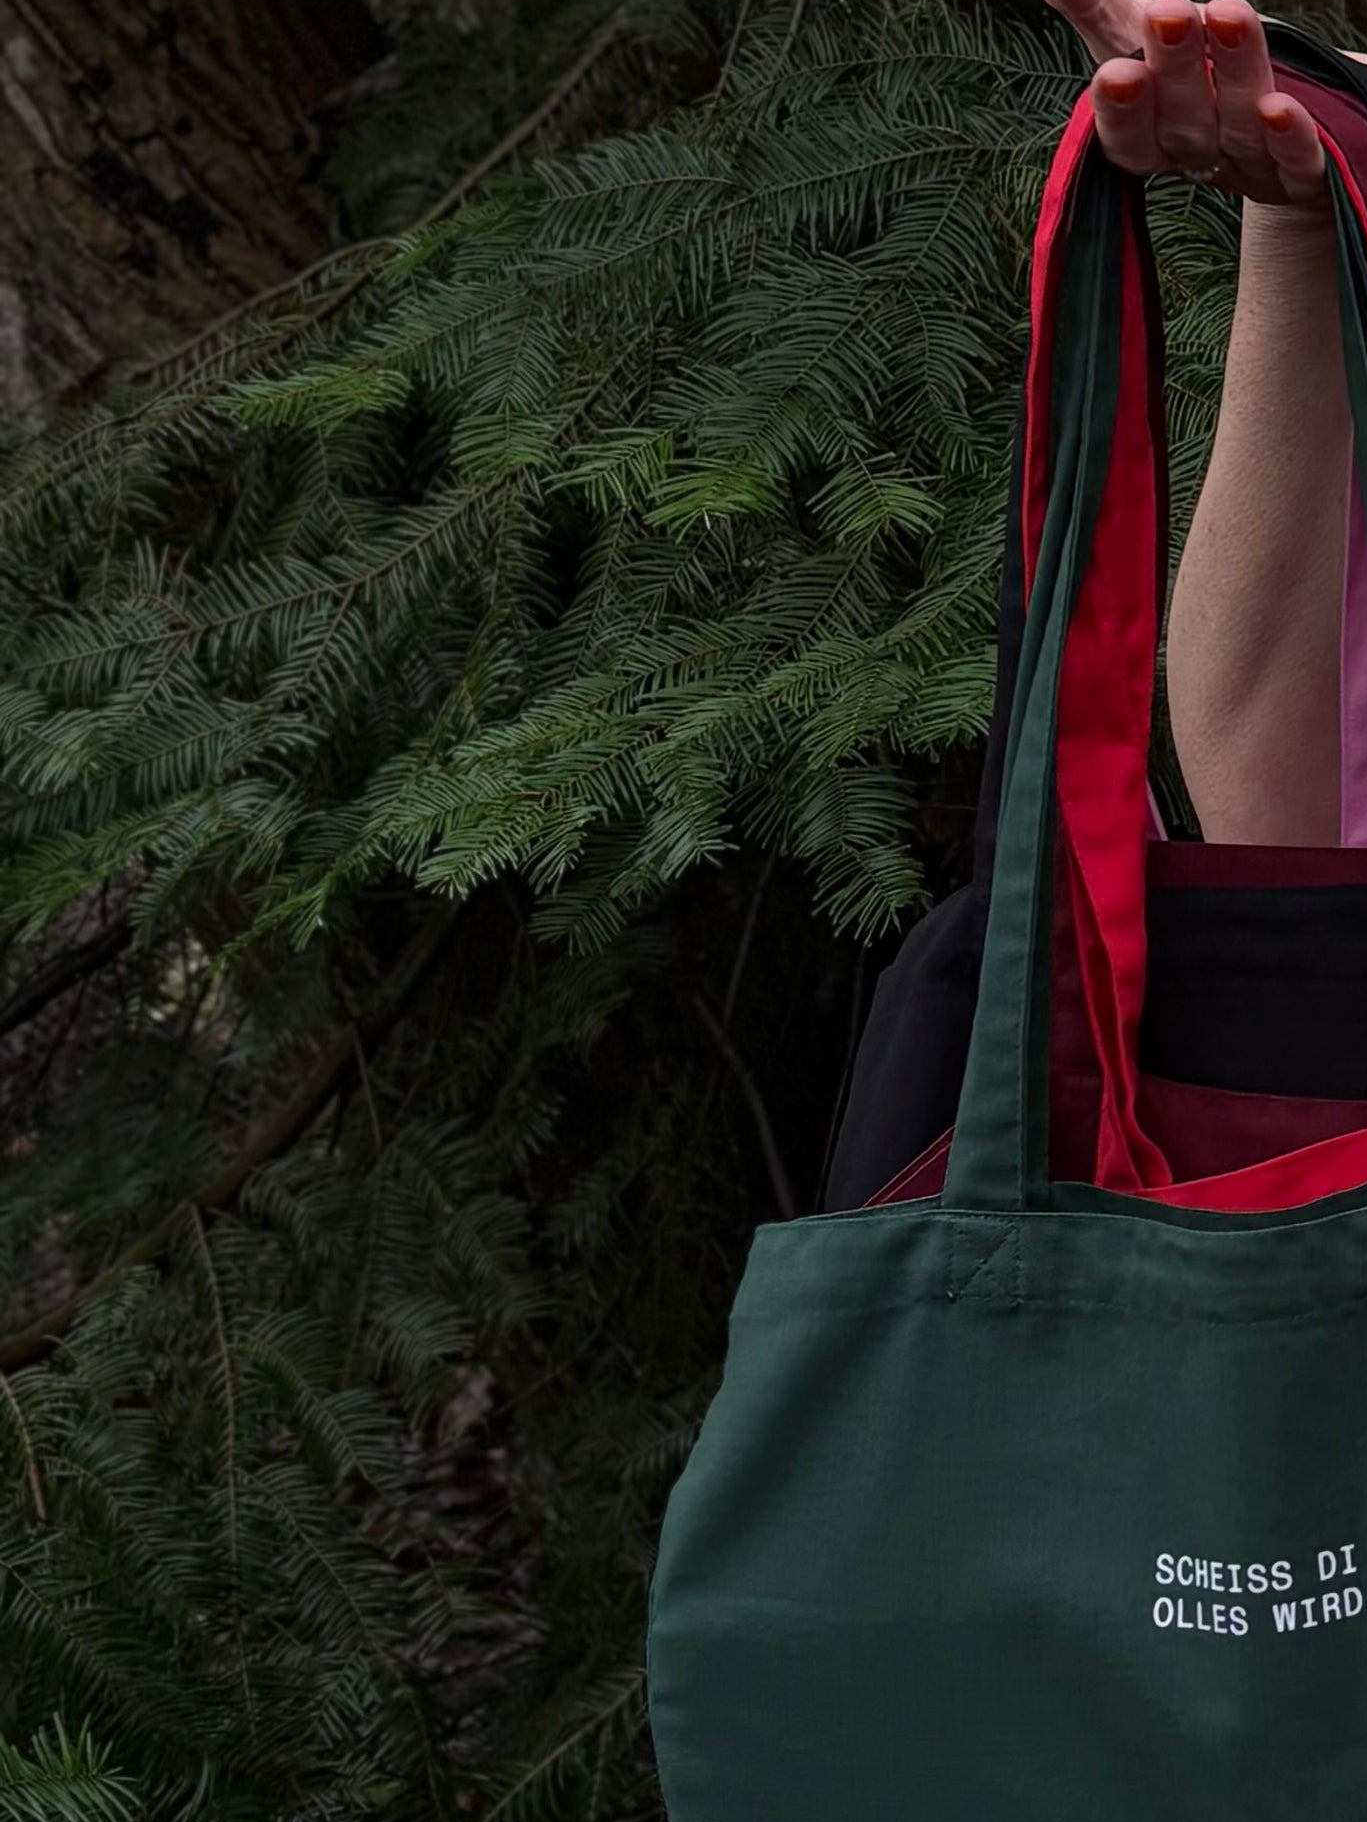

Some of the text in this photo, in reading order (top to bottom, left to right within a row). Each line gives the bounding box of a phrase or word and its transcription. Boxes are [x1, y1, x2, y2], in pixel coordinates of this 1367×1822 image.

[1155, 1553, 1293, 1594] SCHEISS
[1318, 1543, 1357, 1581] DI
[1153, 1596, 1249, 1636] OLLES
[1272, 1587, 1363, 1633] WIRD
